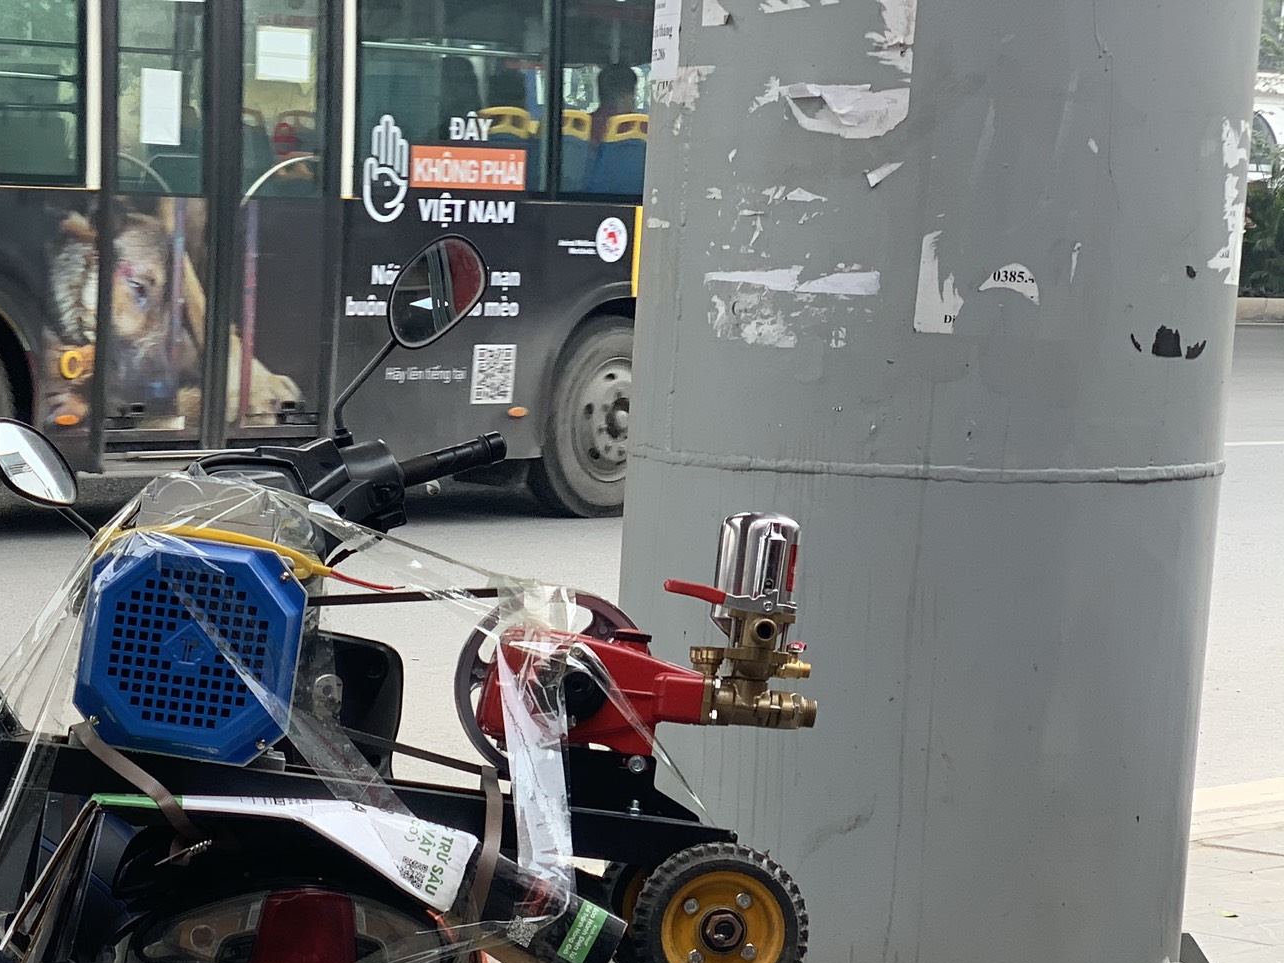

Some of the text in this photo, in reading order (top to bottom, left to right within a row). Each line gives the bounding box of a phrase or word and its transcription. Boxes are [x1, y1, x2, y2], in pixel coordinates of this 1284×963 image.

[449, 111, 493, 141] ĐÂY
[413, 151, 525, 185] KHÔNG PHẢI
[418, 192, 516, 227] VIỆT NAM
[436, 836, 454, 866] TRỪ
[425, 864, 444, 896] SÂU
